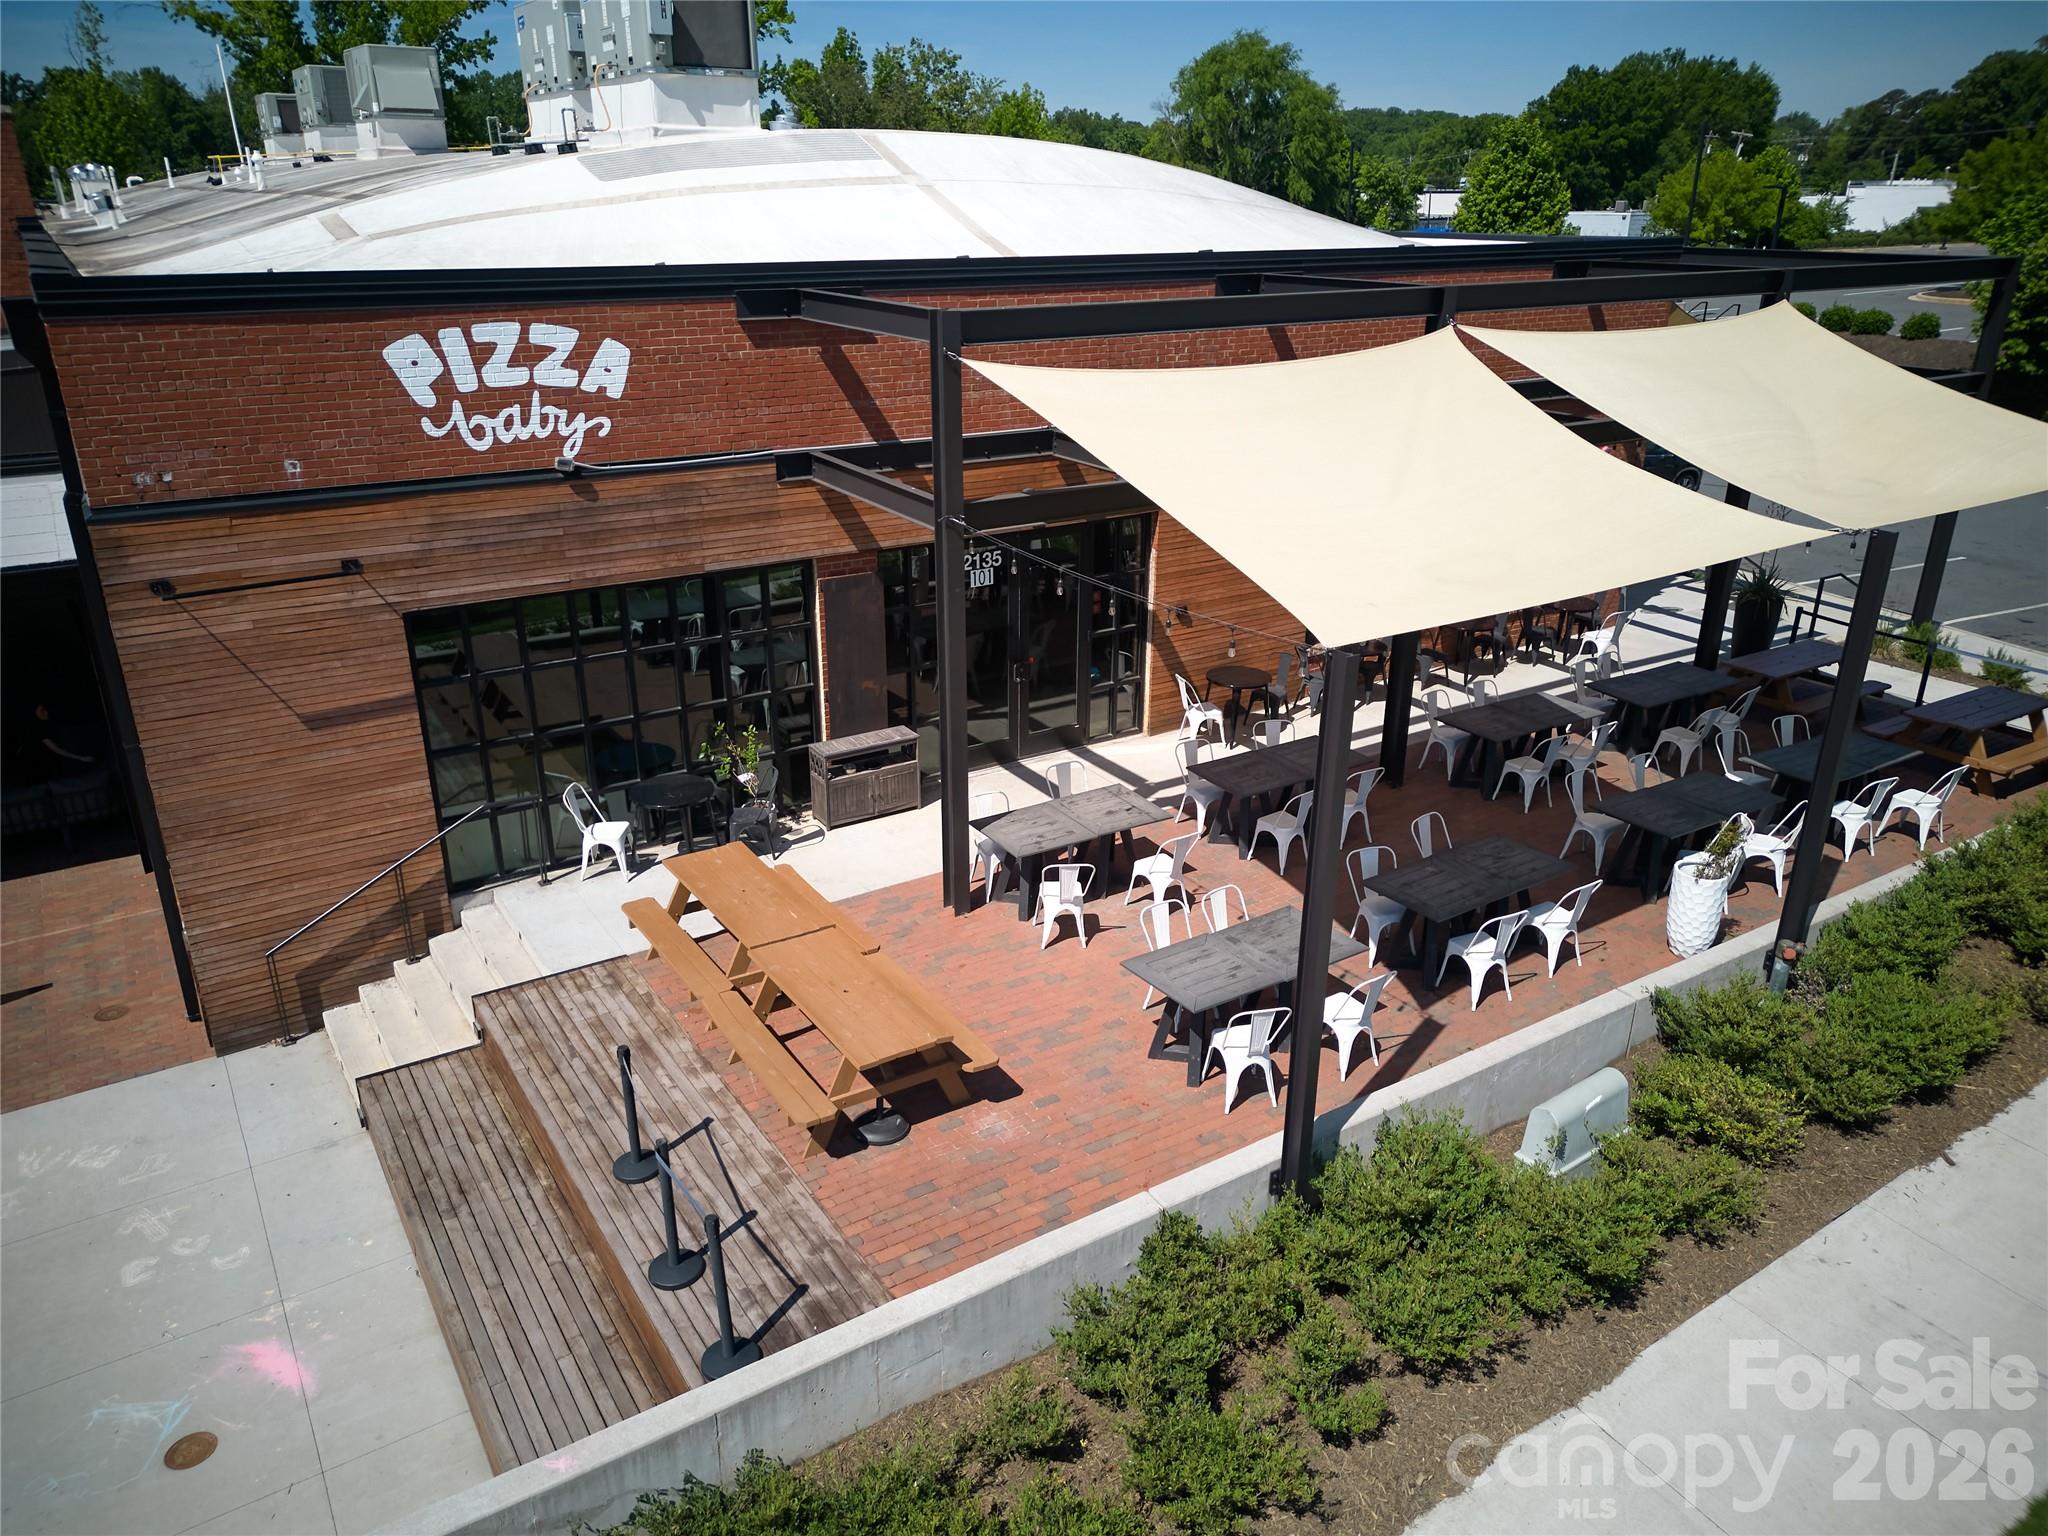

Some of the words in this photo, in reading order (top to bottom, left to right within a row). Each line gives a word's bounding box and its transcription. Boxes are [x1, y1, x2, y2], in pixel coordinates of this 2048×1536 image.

[382, 321, 631, 408] PIZZA
[420, 390, 612, 458] baby
[963, 550, 1003, 571] 2135
[971, 568, 993, 587] 101
